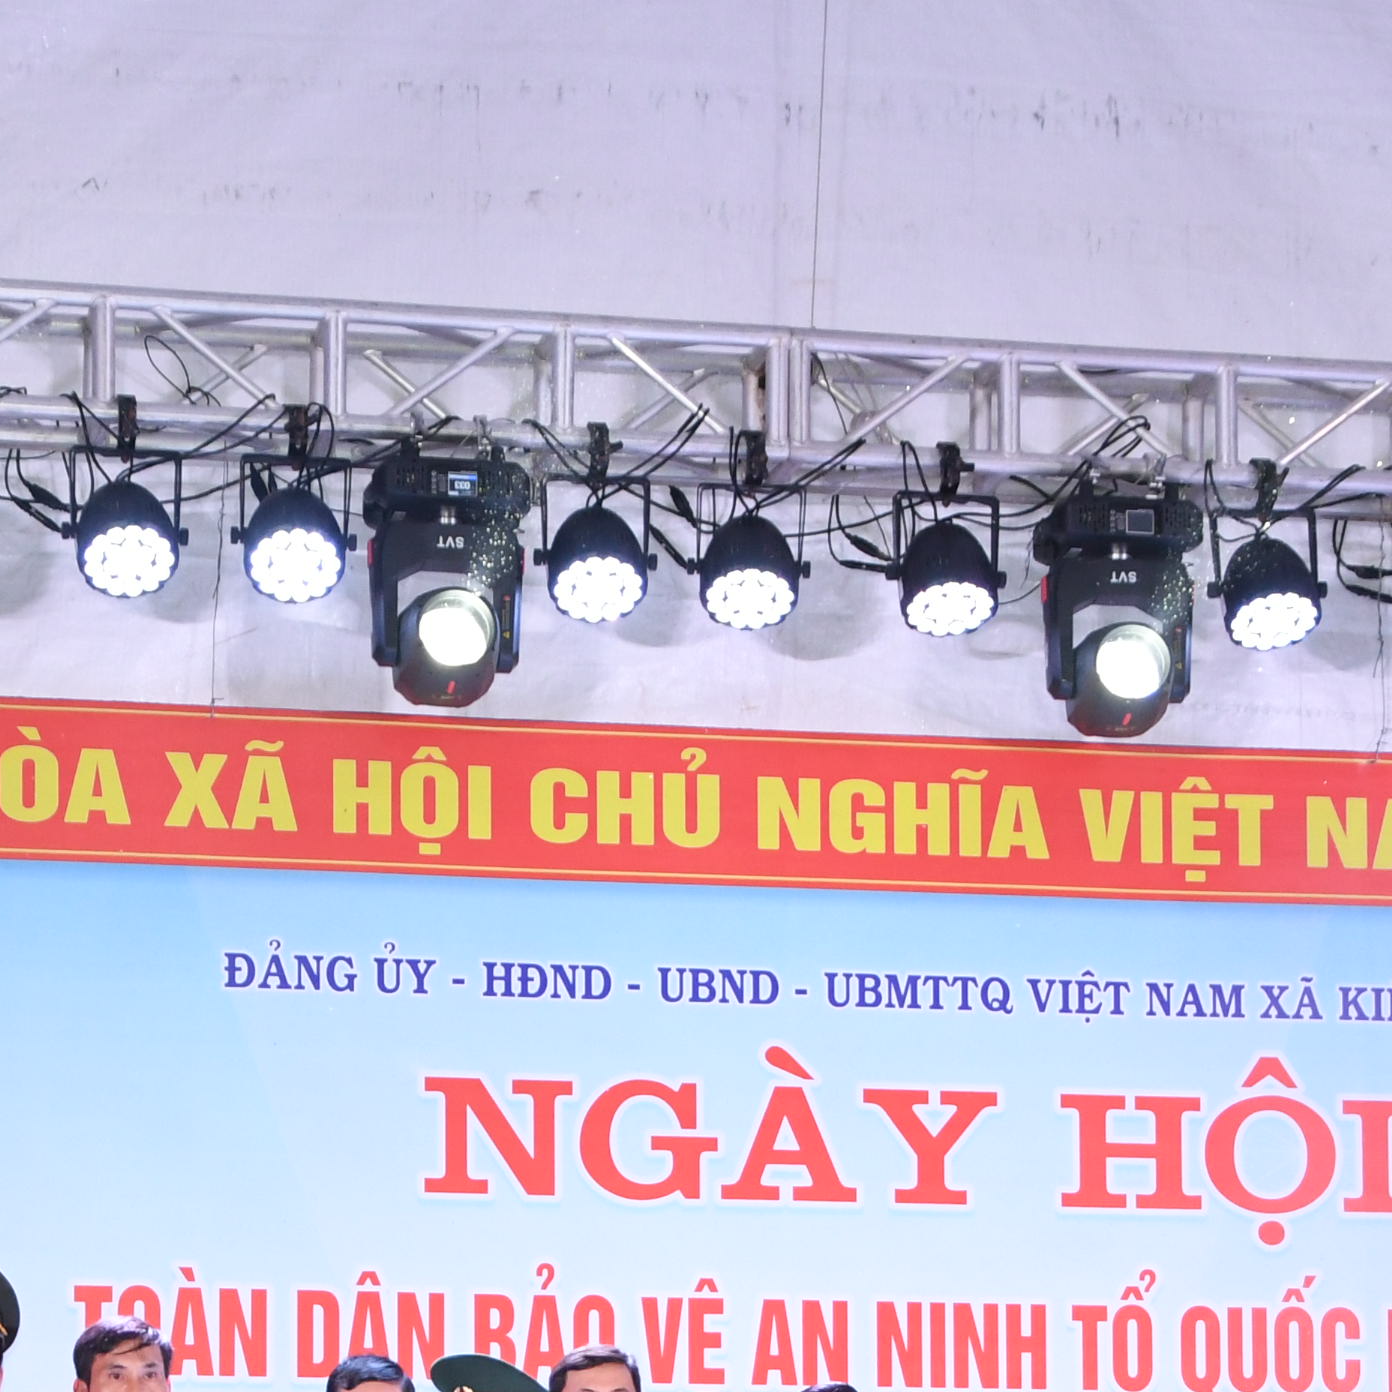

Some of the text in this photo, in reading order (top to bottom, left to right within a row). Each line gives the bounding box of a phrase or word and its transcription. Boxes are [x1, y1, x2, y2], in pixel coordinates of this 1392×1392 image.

[436, 536, 465, 549] SVT
[1109, 571, 1137, 584] SVT
[165, 740, 299, 835] XÃ
[334, 746, 493, 858] HỘI
[530, 748, 722, 854] CHỦ
[756, 768, 1049, 862] NGHĨA
[1078, 776, 1275, 882] VIỆT
[224, 939, 358, 992] ĐẢNG
[374, 942, 437, 994] ỦY
[482, 961, 612, 1000] HĐND
[658, 967, 780, 1005] UBND
[824, 972, 1014, 1015] UBMTTQ
[1027, 969, 1131, 1023] VIỆT
[1145, 982, 1246, 1018] NAM
[1261, 976, 1323, 1020] XÃ
[424, 1046, 998, 1205] NGÀY
[297, 1271, 445, 1380] DÂN
[752, 1299, 849, 1387] AN
[877, 1301, 1047, 1390] NINH
[1071, 1268, 1157, 1392] TỔ
